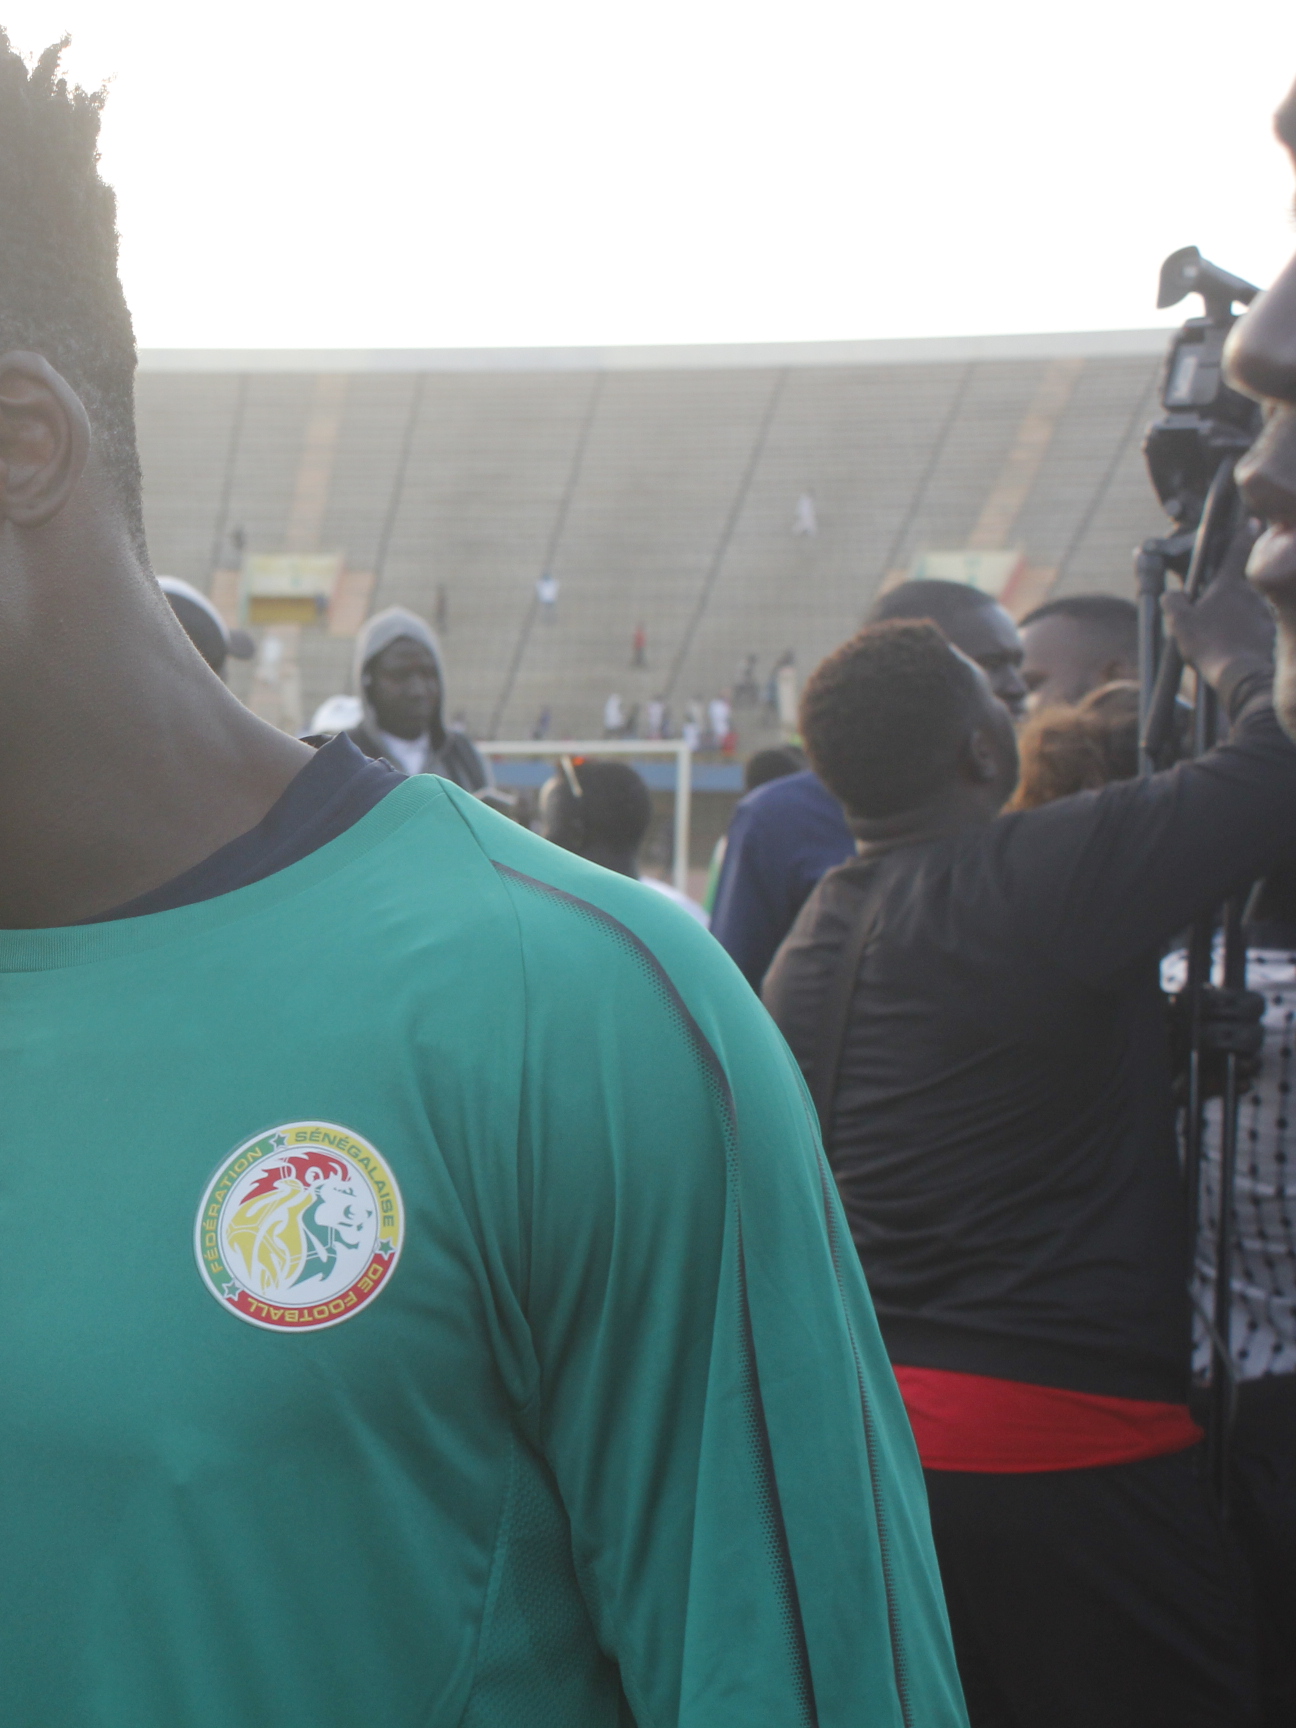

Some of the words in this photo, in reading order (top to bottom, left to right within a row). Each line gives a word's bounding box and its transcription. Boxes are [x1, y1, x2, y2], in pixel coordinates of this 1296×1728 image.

[203, 1147, 263, 1273] FÉDÉRATION
[295, 1128, 394, 1227] SÉNÉGALAISE
[247, 1291, 359, 1322] FOOTBALL
[357, 1263, 384, 1293] DE
